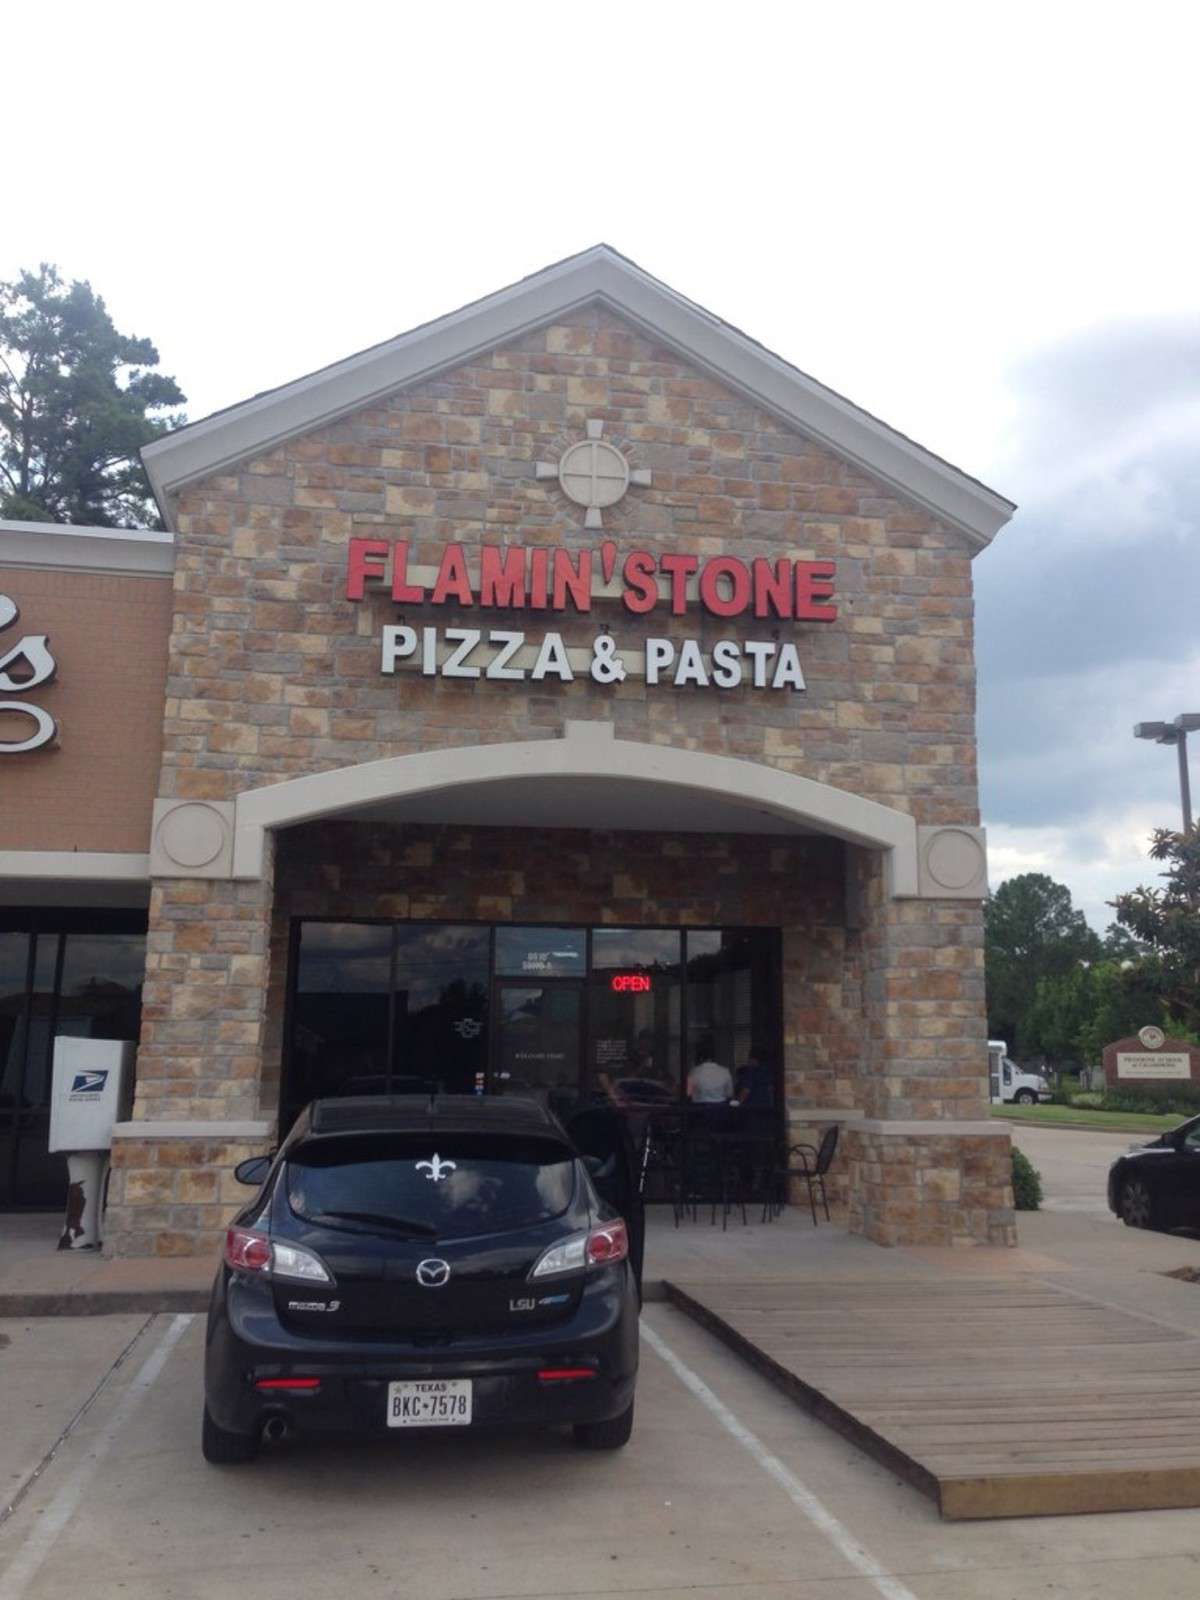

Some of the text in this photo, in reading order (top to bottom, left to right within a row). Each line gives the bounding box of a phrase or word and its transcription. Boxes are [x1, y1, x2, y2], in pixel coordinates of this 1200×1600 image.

[380, 624, 806, 692] PIZZA & PASTA
[611, 975, 651, 992] OPEN
[509, 1298, 536, 1311] LSU
[415, 1383, 447, 1392] TEXAS
